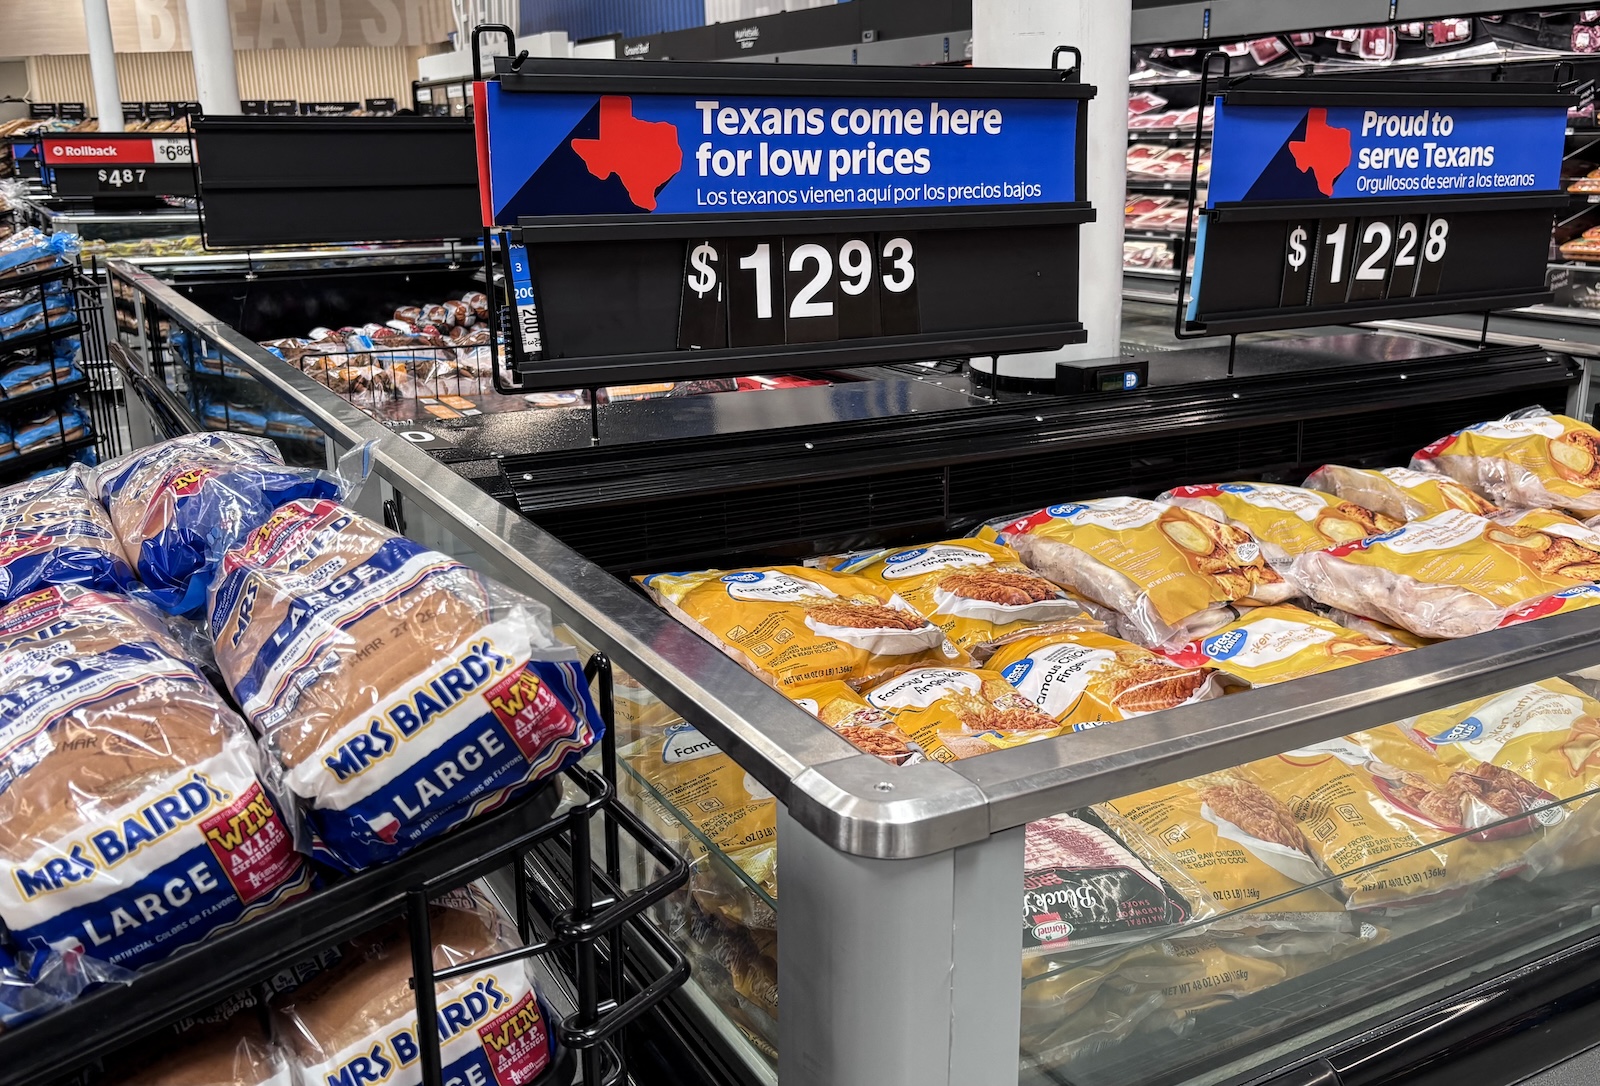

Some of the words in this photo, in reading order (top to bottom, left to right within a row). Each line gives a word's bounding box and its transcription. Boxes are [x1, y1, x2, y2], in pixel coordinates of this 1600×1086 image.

[136, 0, 342, 52] BEAD
[695, 101, 825, 135] Texans
[830, 107, 923, 135] come
[929, 102, 1003, 135] here
[1361, 109, 1430, 137] Proud
[1431, 111, 1454, 137] to
[64, 145, 118, 157] Rollback
[696, 142, 752, 177] for
[759, 142, 823, 176] low
[828, 141, 931, 182] prices
[1357, 146, 1420, 170] serve
[1422, 142, 1495, 169] Texans
[697, 188, 727, 205] Los
[729, 187, 797, 205] texanos
[799, 186, 855, 204] vienen
[857, 185, 892, 205] aquí
[894, 187, 921, 204] por
[923, 184, 945, 200] los
[947, 183, 1001, 202] precios
[1003, 181, 1042, 200] bajos
[1356, 175, 1420, 194] Orgullosos
[1421, 174, 1436, 190] de
[1436, 173, 1468, 189] servir
[1467, 176, 1475, 188] a
[1476, 173, 1493, 188] los
[1493, 173, 1535, 187] texanos
[515, 262, 523, 273] 3
[890, 555, 936, 574] Famous
[937, 549, 986, 559] Chicken
[921, 556, 964, 568] Fingers
[231, 579, 259, 648] MRS
[272, 563, 378, 647] LARGE
[356, 637, 386, 661] MAR
[390, 620, 409, 638] 27
[798, 650, 815, 660] READY
[822, 644, 840, 653] COOK
[812, 640, 837, 650] CHICKEN
[1220, 631, 1243, 655] Value
[783, 675, 796, 686] NET
[810, 669, 820, 678] OZ
[825, 667, 835, 677] LB)
[877, 676, 923, 702] Famous
[1036, 663, 1062, 706] amous
[324, 718, 393, 780] MRS
[389, 643, 504, 738] BAIRD'S
[514, 718, 526, 731] A
[392, 727, 506, 821] LARGE
[673, 776, 711, 795] Microwave
[409, 830, 422, 841] NO
[493, 754, 524, 779] FLAVORS
[1309, 780, 1343, 803] Microwave
[207, 791, 275, 852] WIN
[700, 811, 728, 830] FROZEN
[724, 812, 748, 829] READY
[748, 806, 758, 814] TO
[728, 805, 745, 819] RAW
[230, 853, 243, 868] A
[239, 820, 279, 857] V.I.P.
[745, 832, 757, 844] OZ
[756, 829, 765, 842] (3
[764, 827, 775, 840] LB)
[1332, 844, 1348, 861] KEEP
[1347, 834, 1374, 850] FROZEN
[231, 830, 286, 877] EXPERIENCE
[1194, 858, 1219, 870] READY
[1217, 857, 1228, 866] TO
[1226, 855, 1249, 865] COOK
[1196, 852, 1215, 862] RAW
[1215, 848, 1245, 858] CHICKEN
[1335, 841, 1375, 866] UNCOOKED
[1374, 836, 1390, 847] RAW
[1391, 834, 1419, 843] CHICKEN
[1339, 851, 1368, 872] FROZEN
[1371, 844, 1392, 856] READY
[1392, 841, 1403, 850] TO
[16, 845, 95, 898] MRS
[1377, 878, 1389, 890] WT
[1403, 874, 1412, 887] (3
[82, 861, 219, 948] LARGE
[1120, 899, 1151, 910] SMOKE
[1212, 889, 1224, 901] OZ
[1223, 889, 1232, 901] (3
[1232, 887, 1243, 901] LB)
[1115, 904, 1165, 919] HARDWOOD
[1125, 914, 1164, 928] NATURAL
[108, 940, 155, 966] ARTIFICIAL
[154, 920, 189, 944] COLORS
[201, 892, 239, 919] FLAVORS
[1038, 923, 1068, 938] Hormel
[1161, 985, 1178, 997] NET
[1178, 983, 1192, 995] WT
[1191, 980, 1203, 991] 48
[1202, 976, 1214, 988] OZ
[1213, 974, 1221, 988] (3
[1219, 971, 1233, 984] LB)
[327, 1044, 392, 1086] MRS
[390, 978, 503, 1066] BIRD'S
[480, 1023, 497, 1034] ENTER
[482, 999, 540, 1052] WIN
[497, 1033, 545, 1074] EXPERIENCE
[498, 1053, 507, 1066] A
[506, 1025, 540, 1056] V.I.P.
